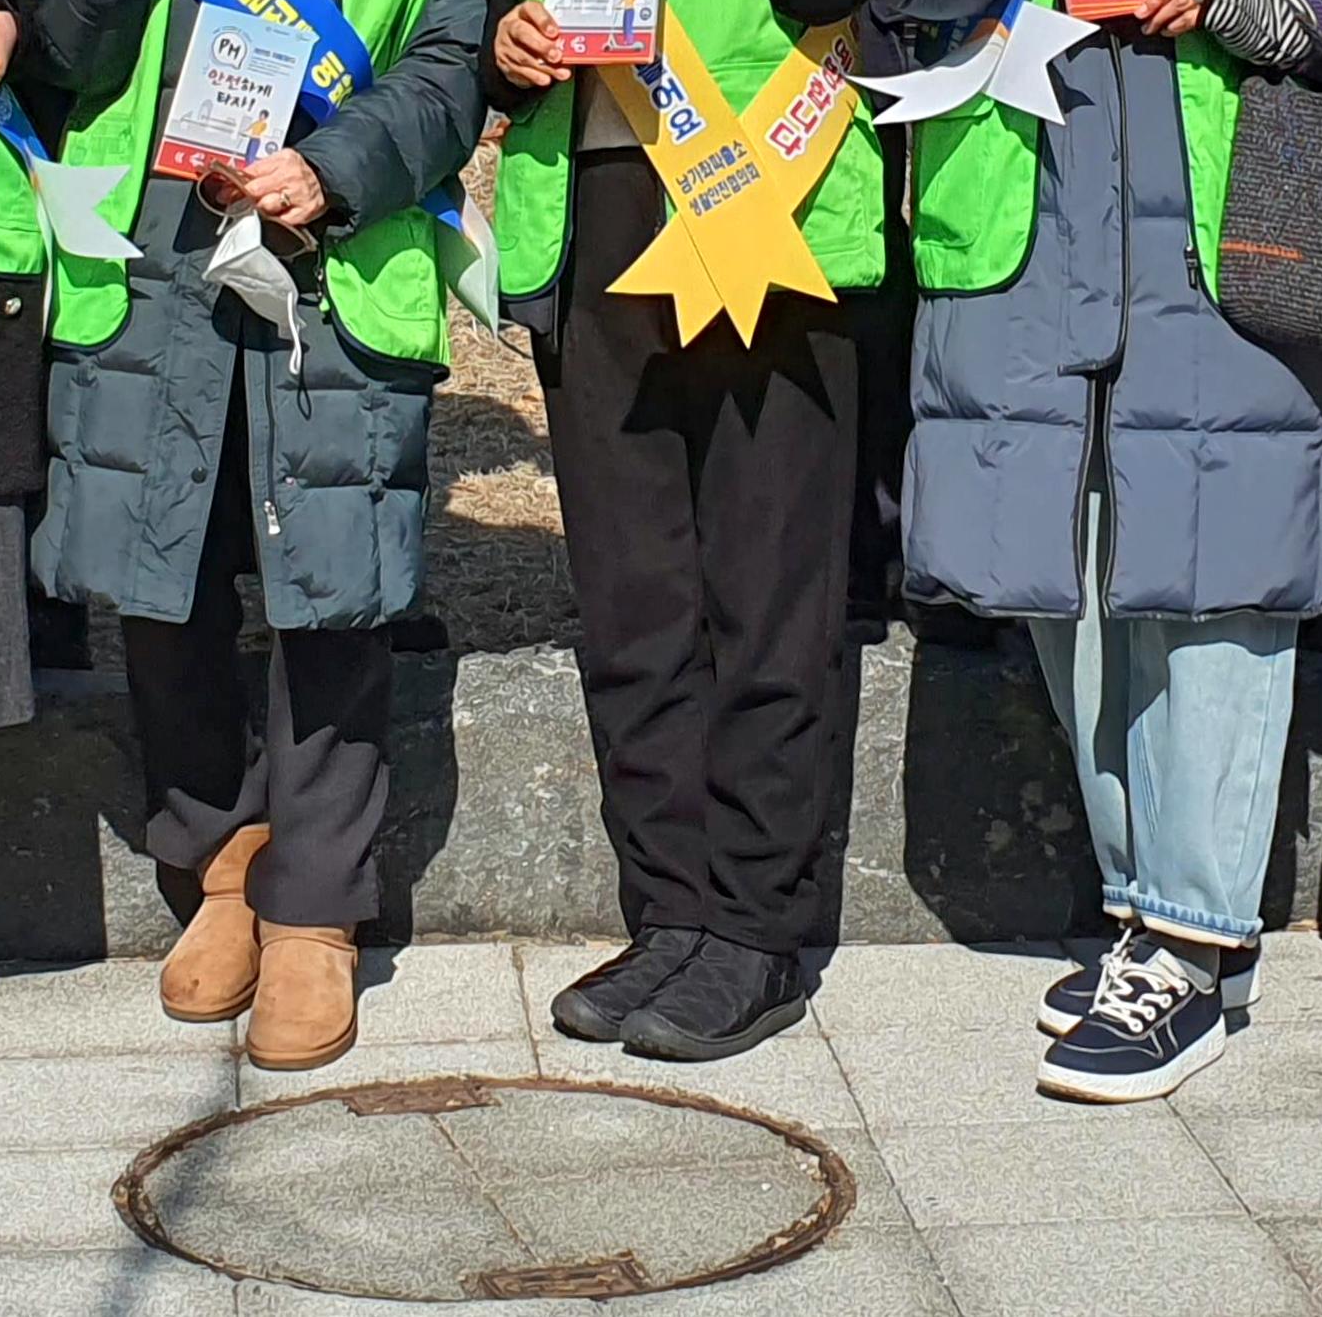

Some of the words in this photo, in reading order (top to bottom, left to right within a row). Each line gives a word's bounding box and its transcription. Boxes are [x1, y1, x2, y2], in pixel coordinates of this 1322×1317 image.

[219, 38, 240, 60] PM
[207, 67, 273, 98] 안전하게
[675, 140, 748, 194] 남가좌파출소
[689, 162, 761, 216] 생활안전협의회
